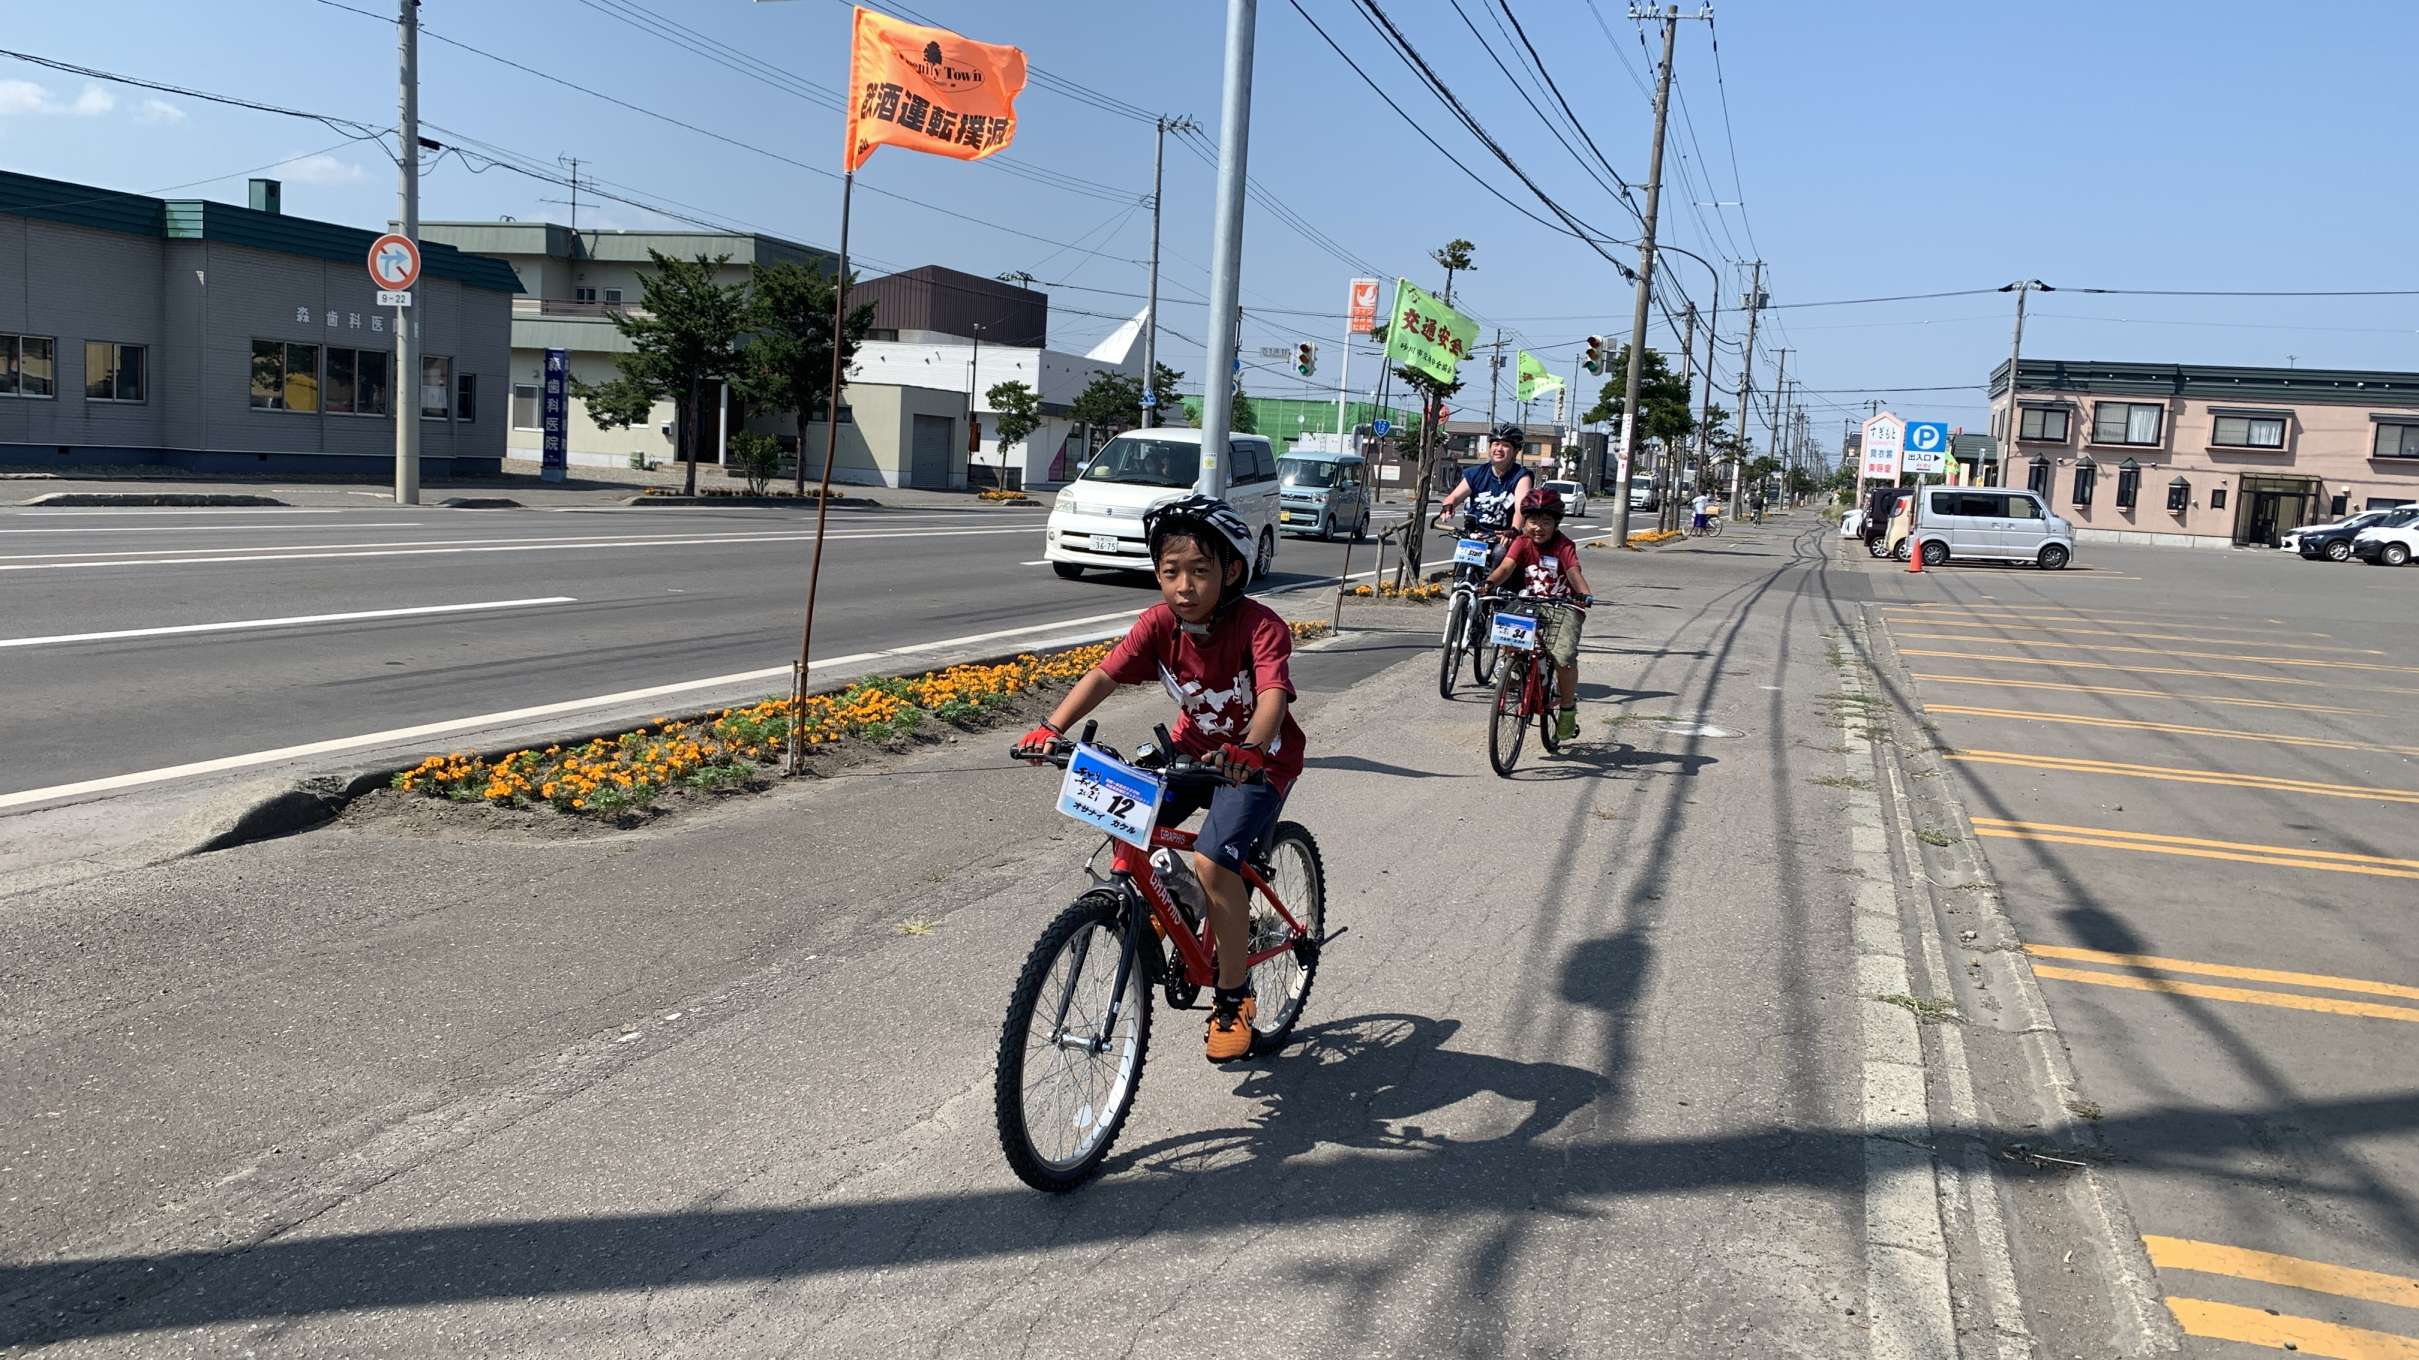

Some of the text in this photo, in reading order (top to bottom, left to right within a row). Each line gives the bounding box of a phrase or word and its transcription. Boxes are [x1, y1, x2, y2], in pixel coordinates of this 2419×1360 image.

[943, 66, 983, 82] Town
[382, 294, 406, 304] 9-22
[1401, 308, 1463, 356] 交通安全
[1919, 428, 1936, 446] P
[1908, 453, 1932, 461] 出入口
[1512, 628, 1527, 640] 34
[1106, 794, 1136, 820] 12
[1072, 801, 1137, 835] オサナイ カケル
